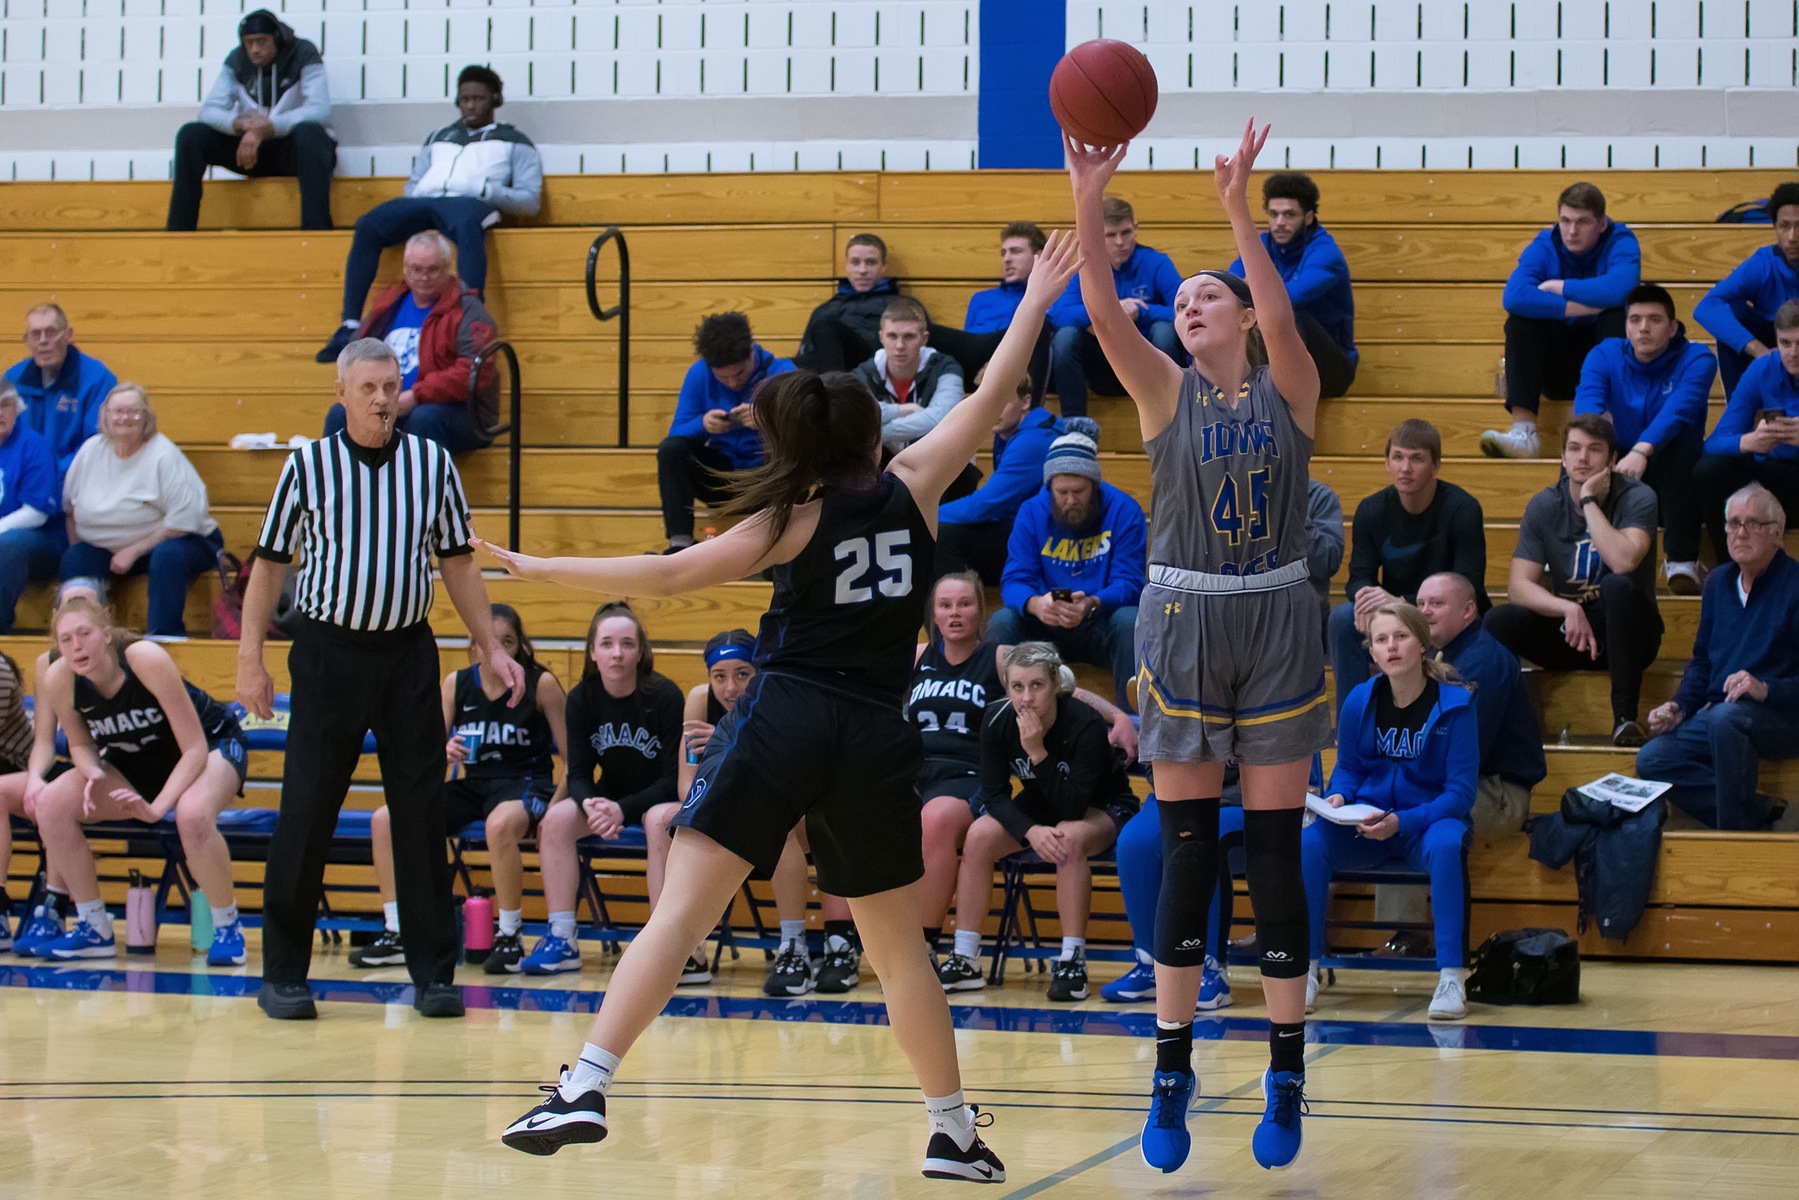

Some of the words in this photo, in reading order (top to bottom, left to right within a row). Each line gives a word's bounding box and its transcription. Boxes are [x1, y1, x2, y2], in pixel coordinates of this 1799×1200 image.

[1201, 419, 1280, 466] IOWA
[1211, 464, 1271, 547] 45
[834, 529, 913, 605] 25
[909, 678, 986, 708] DMACC
[917, 710, 971, 734] 24
